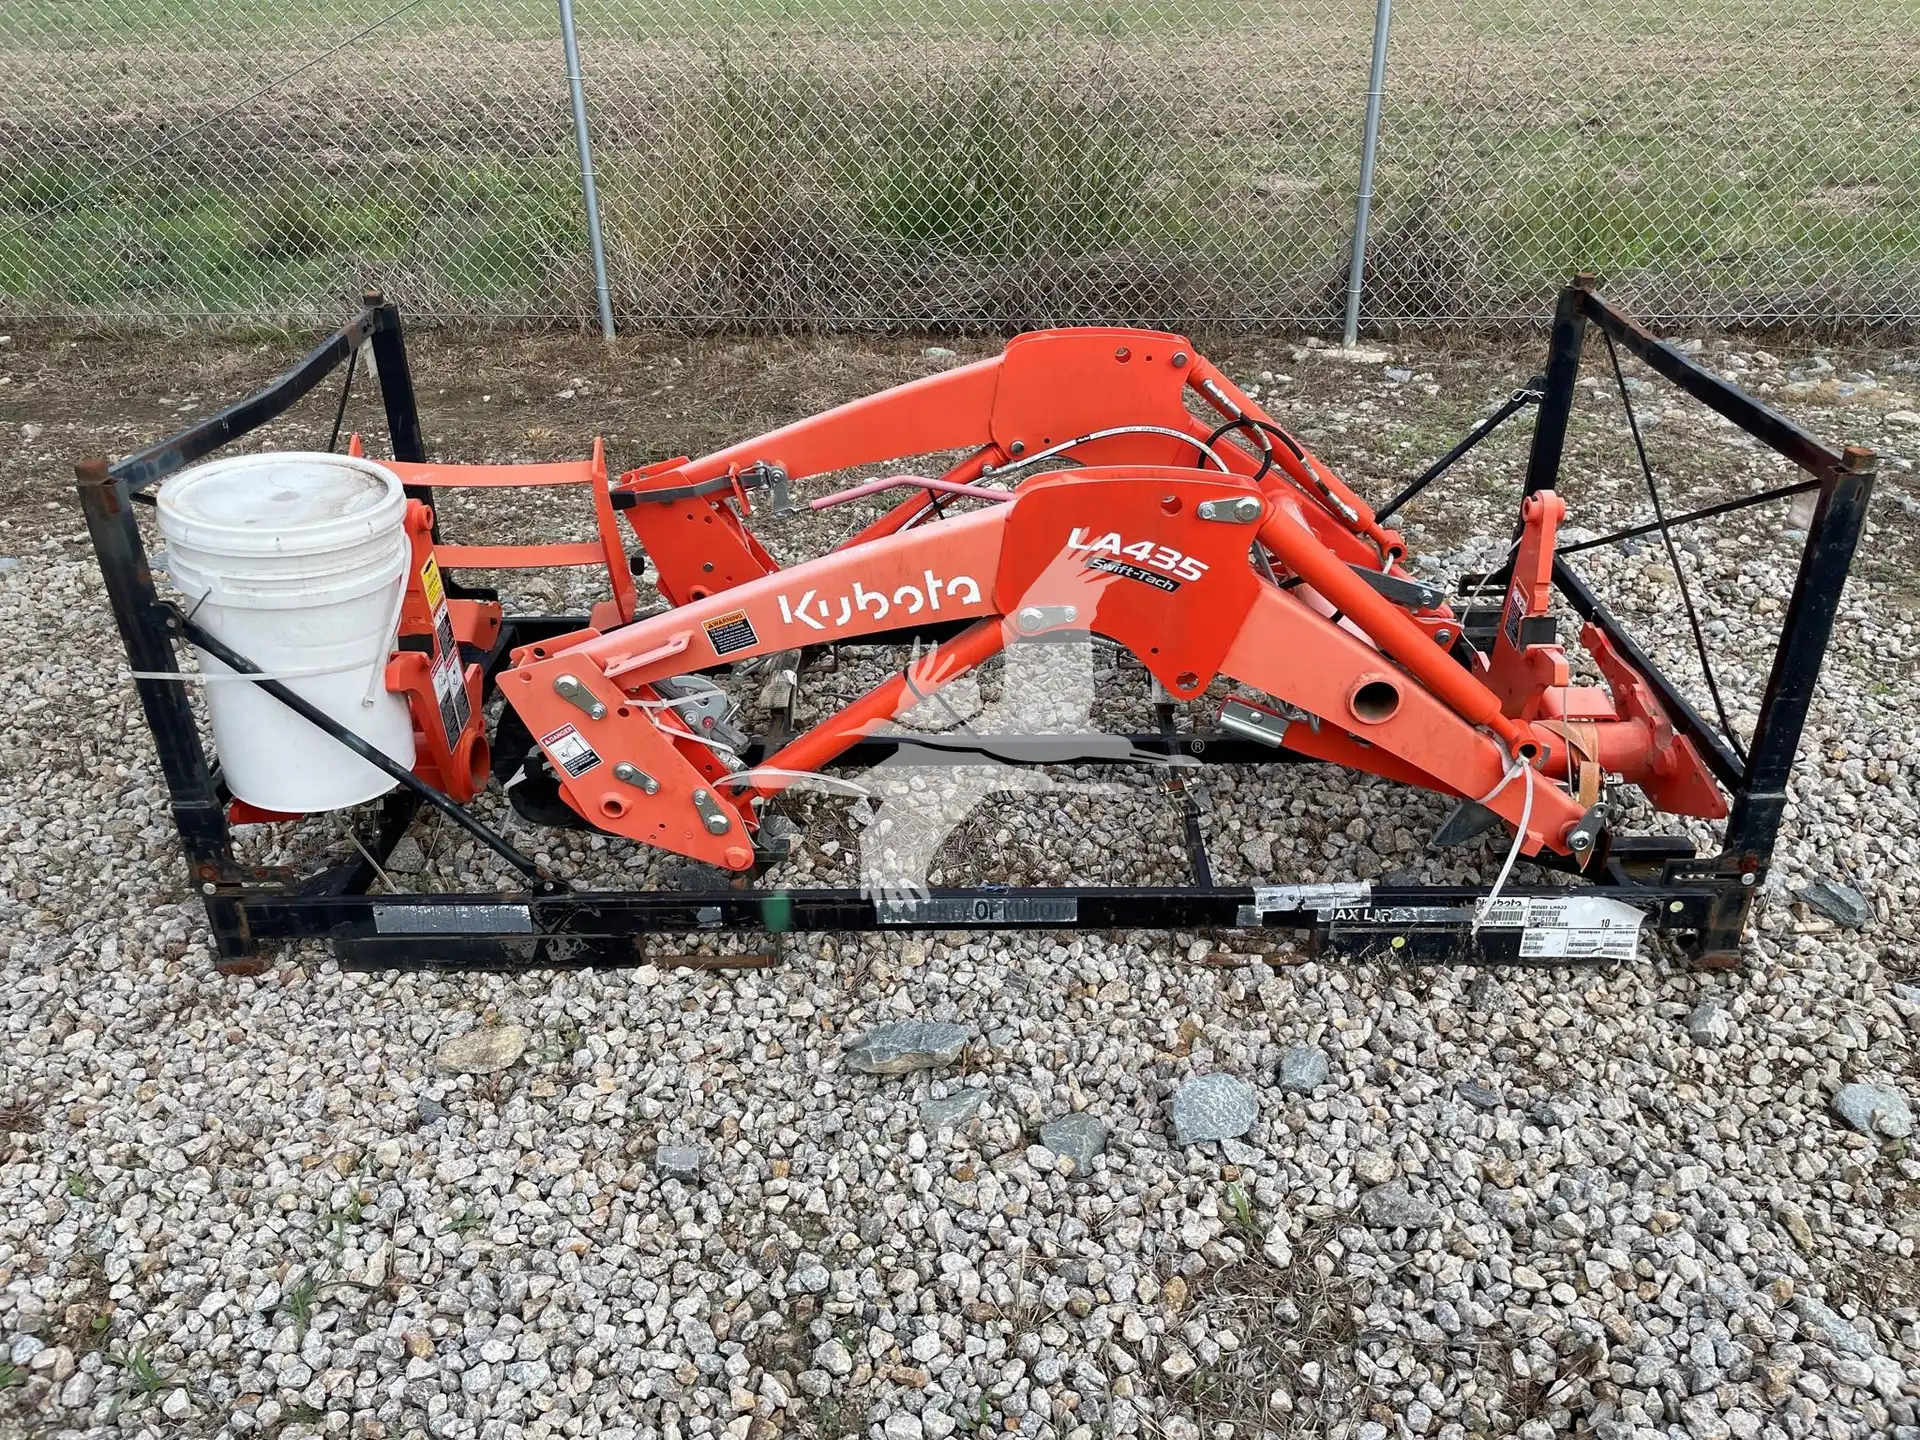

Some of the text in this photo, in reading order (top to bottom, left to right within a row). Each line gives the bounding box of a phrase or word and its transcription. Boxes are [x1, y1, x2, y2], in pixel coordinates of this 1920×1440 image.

[1067, 527, 1209, 581] LA435
[1089, 557, 1174, 591] Swift-Tach
[776, 569, 982, 630] Kubota
[712, 613, 743, 626] WARNING
[548, 725, 574, 742] DANGER
[1600, 919, 1611, 928] 10
